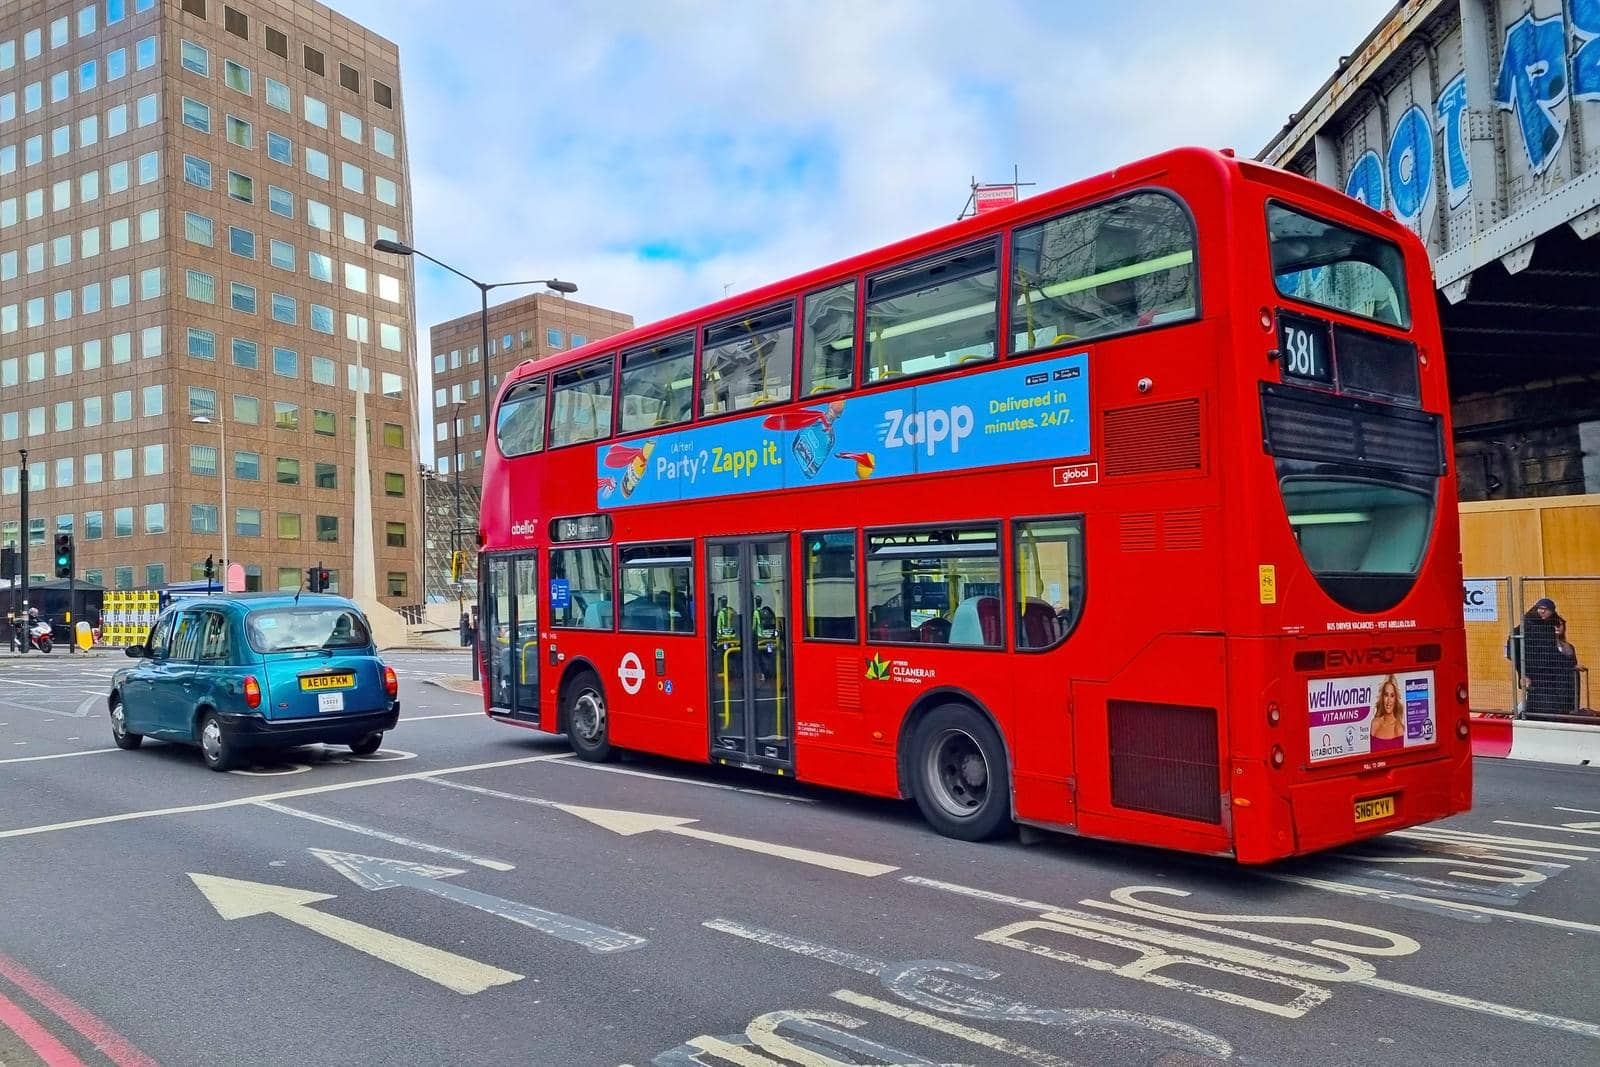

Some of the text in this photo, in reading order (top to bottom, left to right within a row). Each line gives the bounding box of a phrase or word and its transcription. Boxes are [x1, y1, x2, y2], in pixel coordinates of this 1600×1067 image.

[1285, 327, 1315, 376] 381
[989, 390, 1067, 414] Delivered in
[884, 404, 974, 456] Zapp
[984, 409, 1074, 434] minutes. 24/7.
[656, 450, 709, 484] Party?
[711, 447, 758, 478] Zapp
[762, 439, 782, 466] it.
[1062, 466, 1089, 483] global
[511, 519, 535, 535] abellio
[567, 523, 578, 537] 381
[1327, 646, 1394, 667] ENVIRO
[307, 676, 328, 688] AE10
[892, 667, 936, 678] CLEANERAIR
[1309, 681, 1372, 709] wellwoman
[1322, 710, 1359, 723] VITAMINS
[1310, 745, 1344, 758] VITABIOTICS
[974, 884, 1421, 1019] BUS
